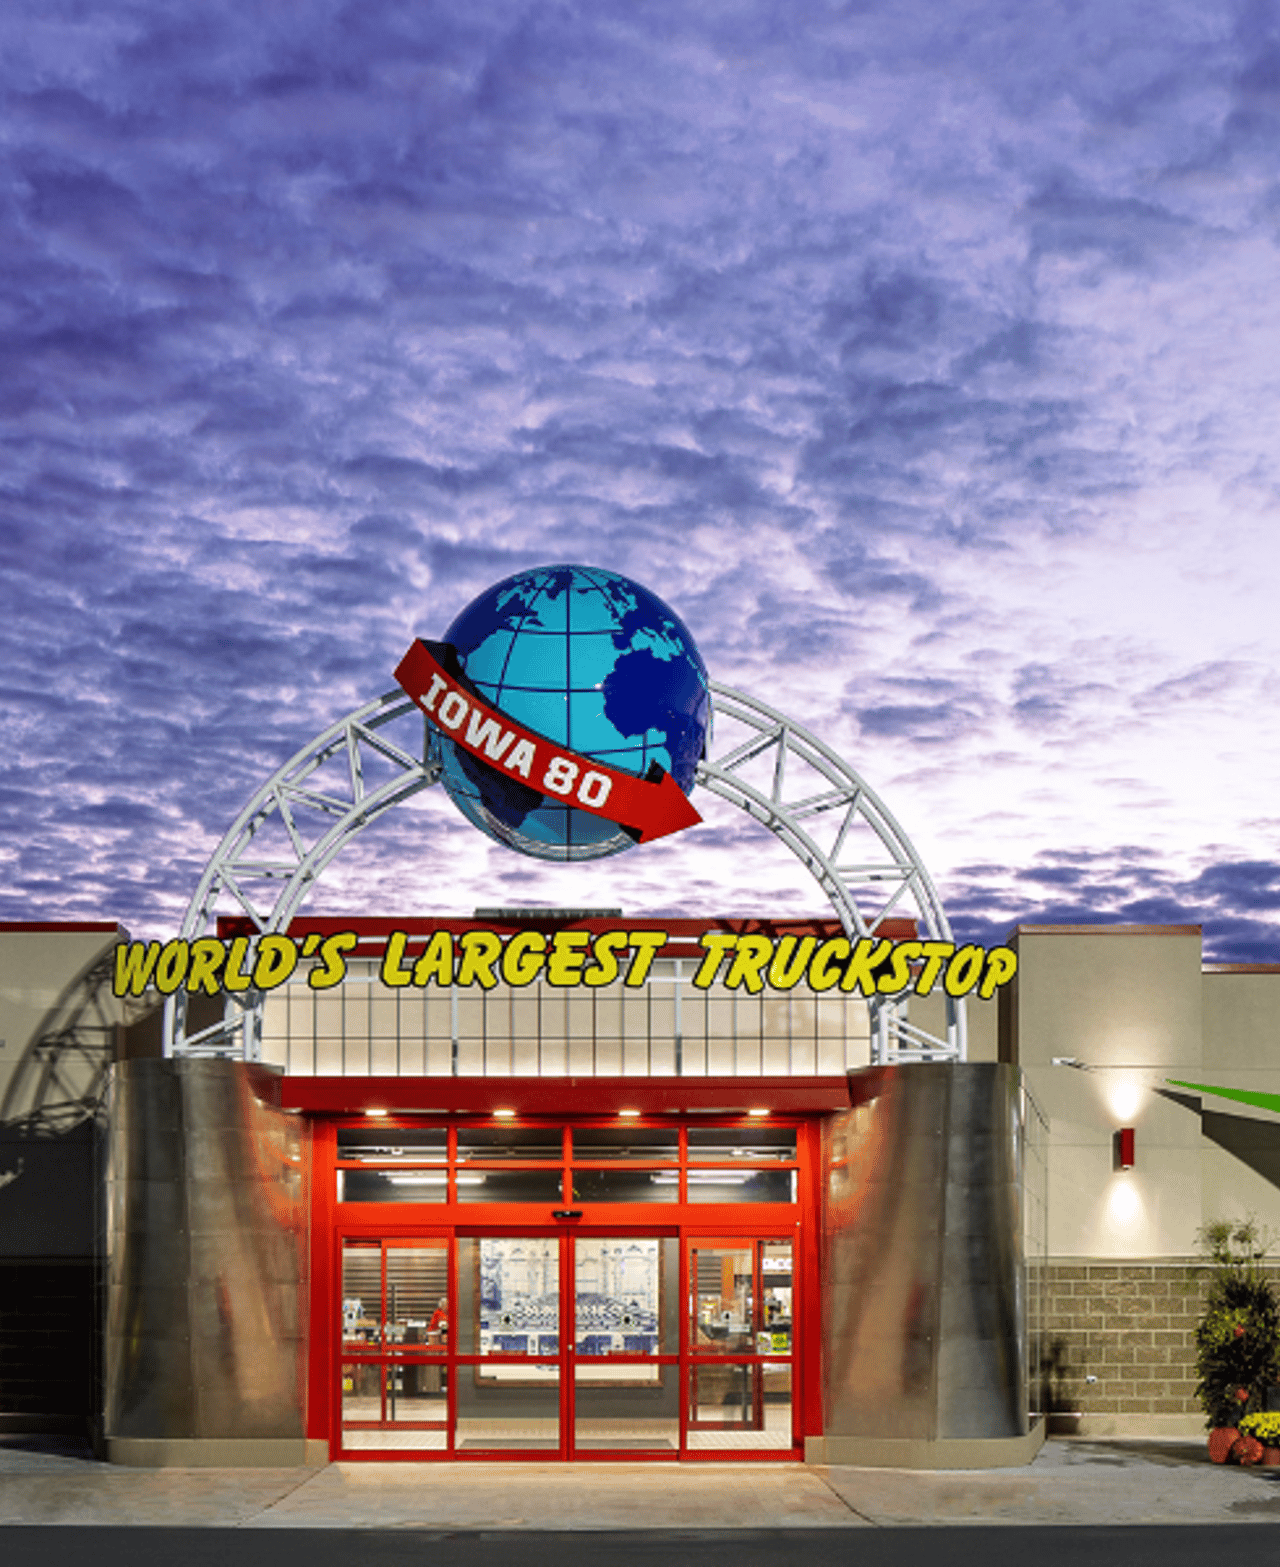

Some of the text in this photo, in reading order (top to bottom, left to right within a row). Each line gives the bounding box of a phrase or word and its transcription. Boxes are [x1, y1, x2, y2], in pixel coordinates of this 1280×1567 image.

[420, 672, 613, 809] IOWA 80
[113, 931, 1018, 998] WORLD'S LARGEST TRUCKSTOP
